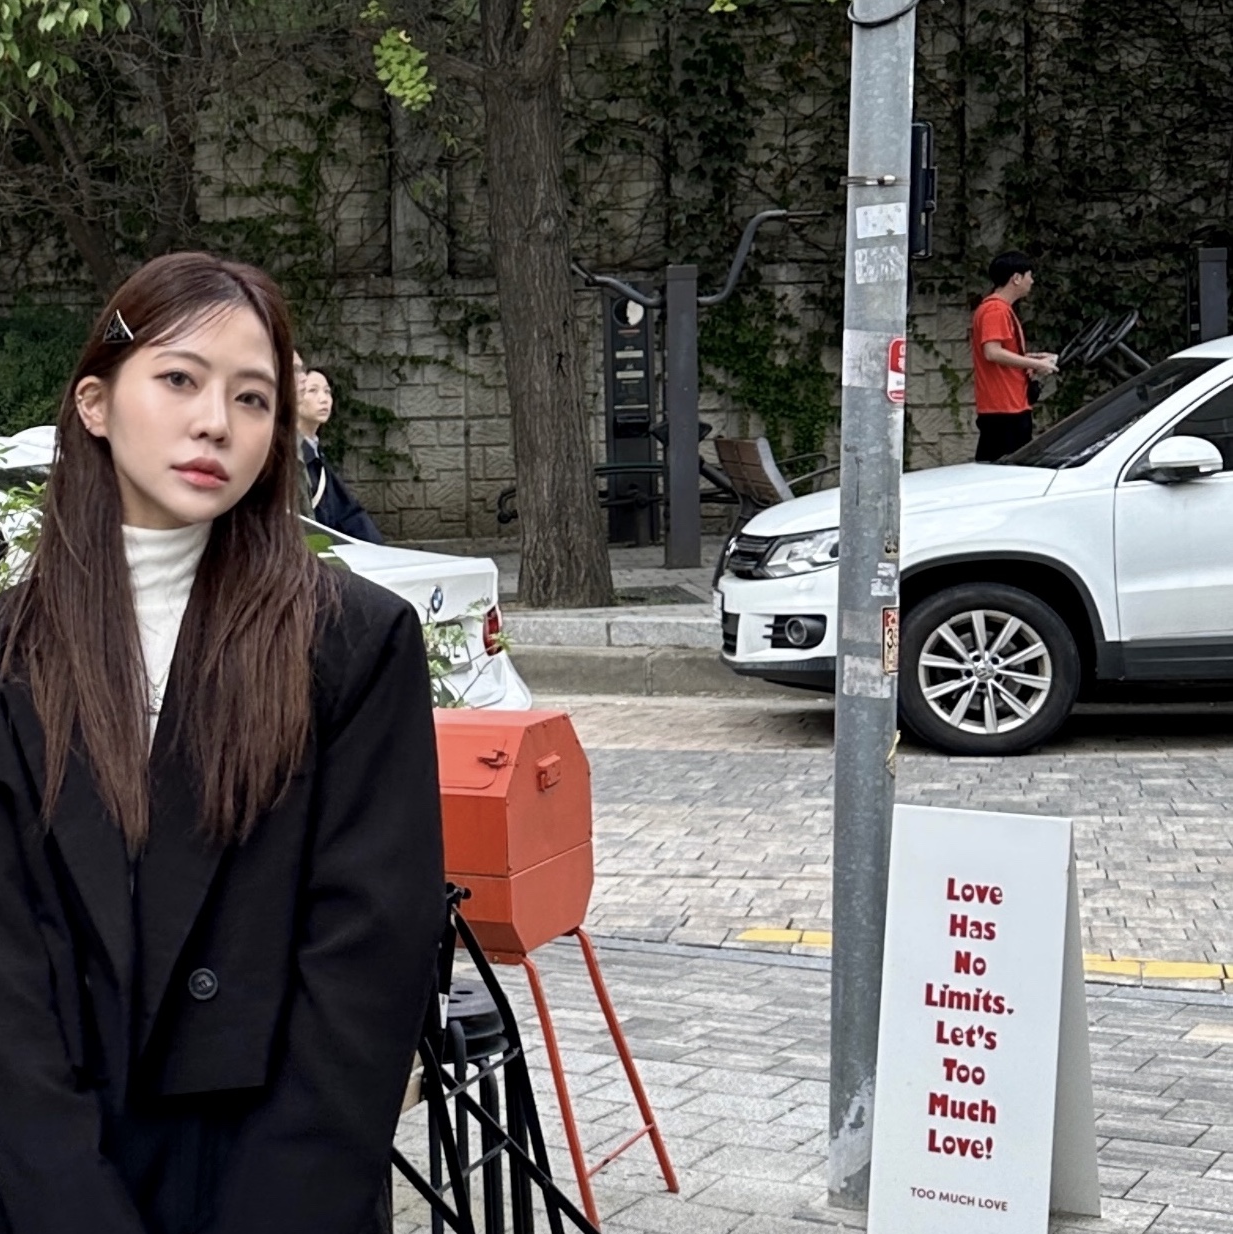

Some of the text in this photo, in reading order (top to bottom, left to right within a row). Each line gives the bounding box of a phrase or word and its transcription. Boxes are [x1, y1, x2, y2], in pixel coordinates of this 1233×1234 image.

[947, 878, 1002, 904] Love
[950, 914, 996, 940] Has
[954, 950, 986, 975] No
[925, 984, 1014, 1014] Limits.
[936, 1021, 996, 1049] Let's
[943, 1058, 985, 1085] Too
[928, 1093, 996, 1123] Much
[928, 1130, 993, 1159] Love!
[910, 1187, 1008, 1211] TOO MUCH LOVE
